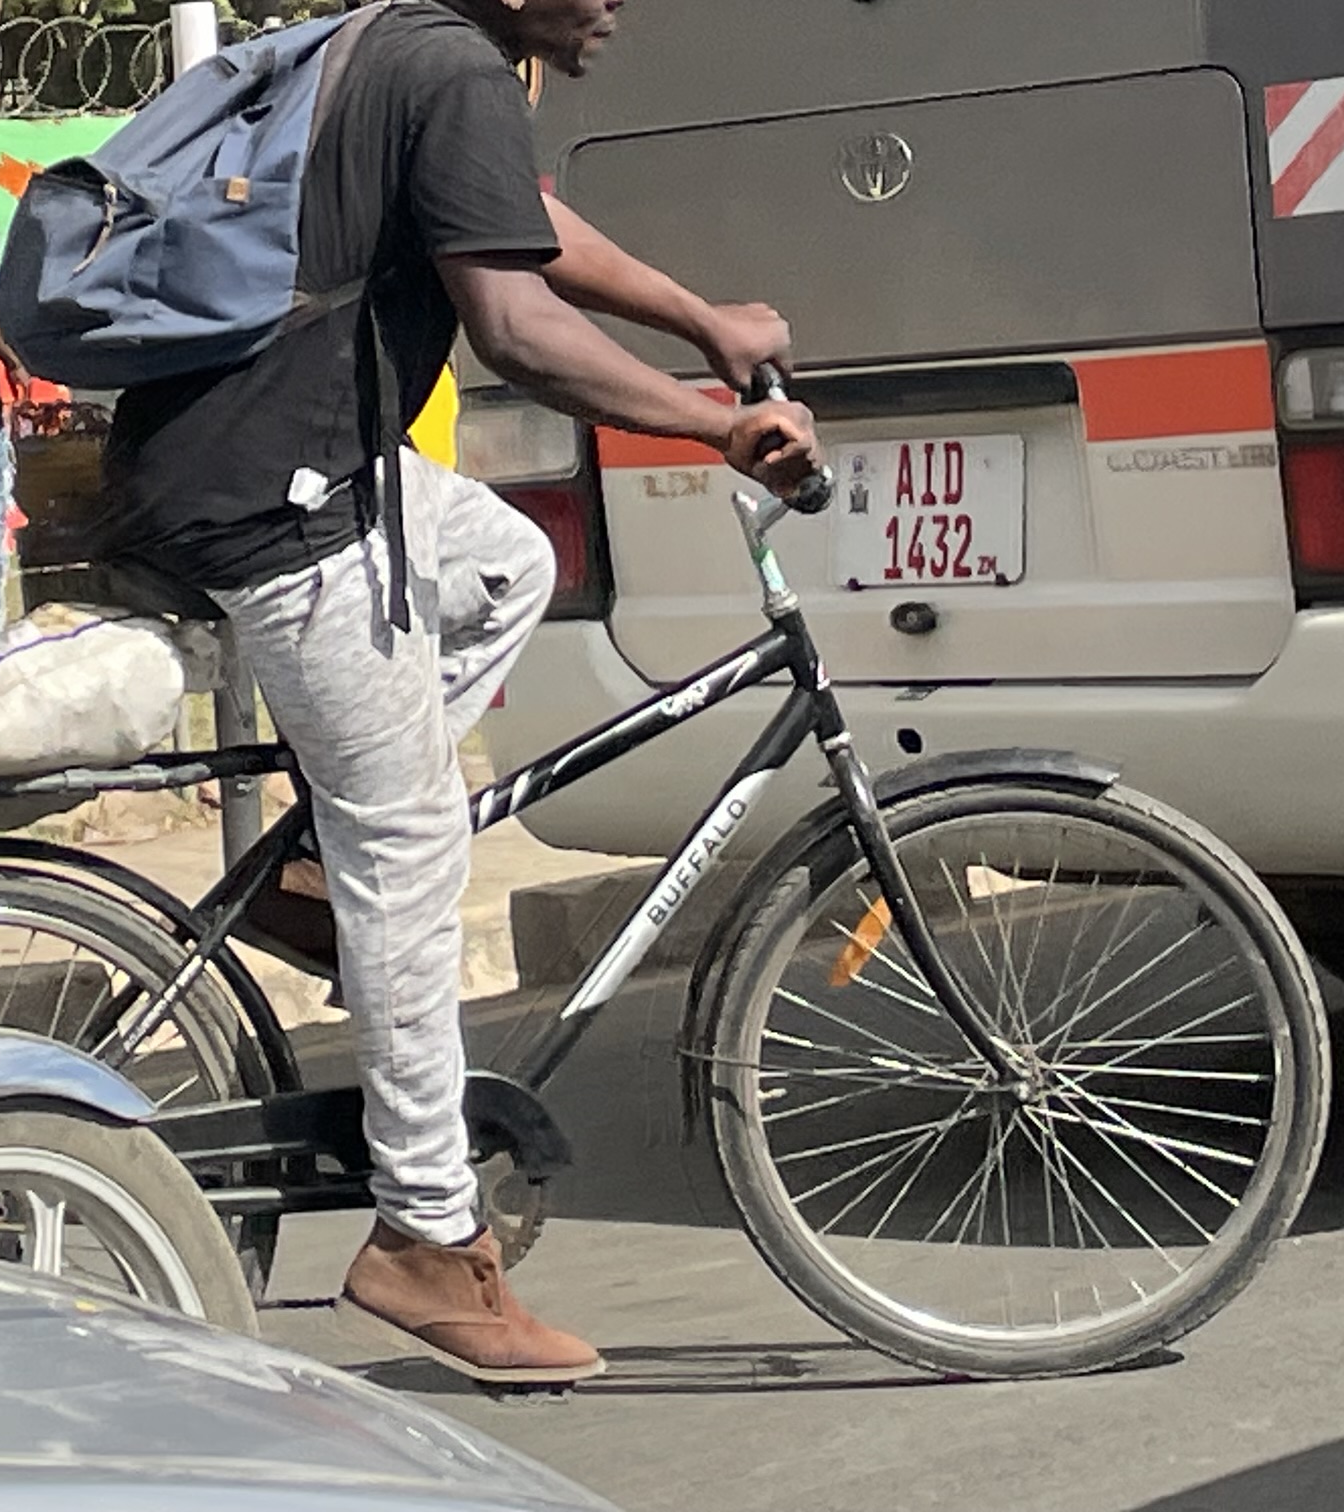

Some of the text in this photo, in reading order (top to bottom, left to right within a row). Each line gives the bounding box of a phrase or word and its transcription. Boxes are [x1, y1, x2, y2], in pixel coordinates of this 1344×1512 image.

[896, 442, 964, 507] AID
[884, 515, 972, 579] 1432
[647, 799, 747, 926] BUFFALO
